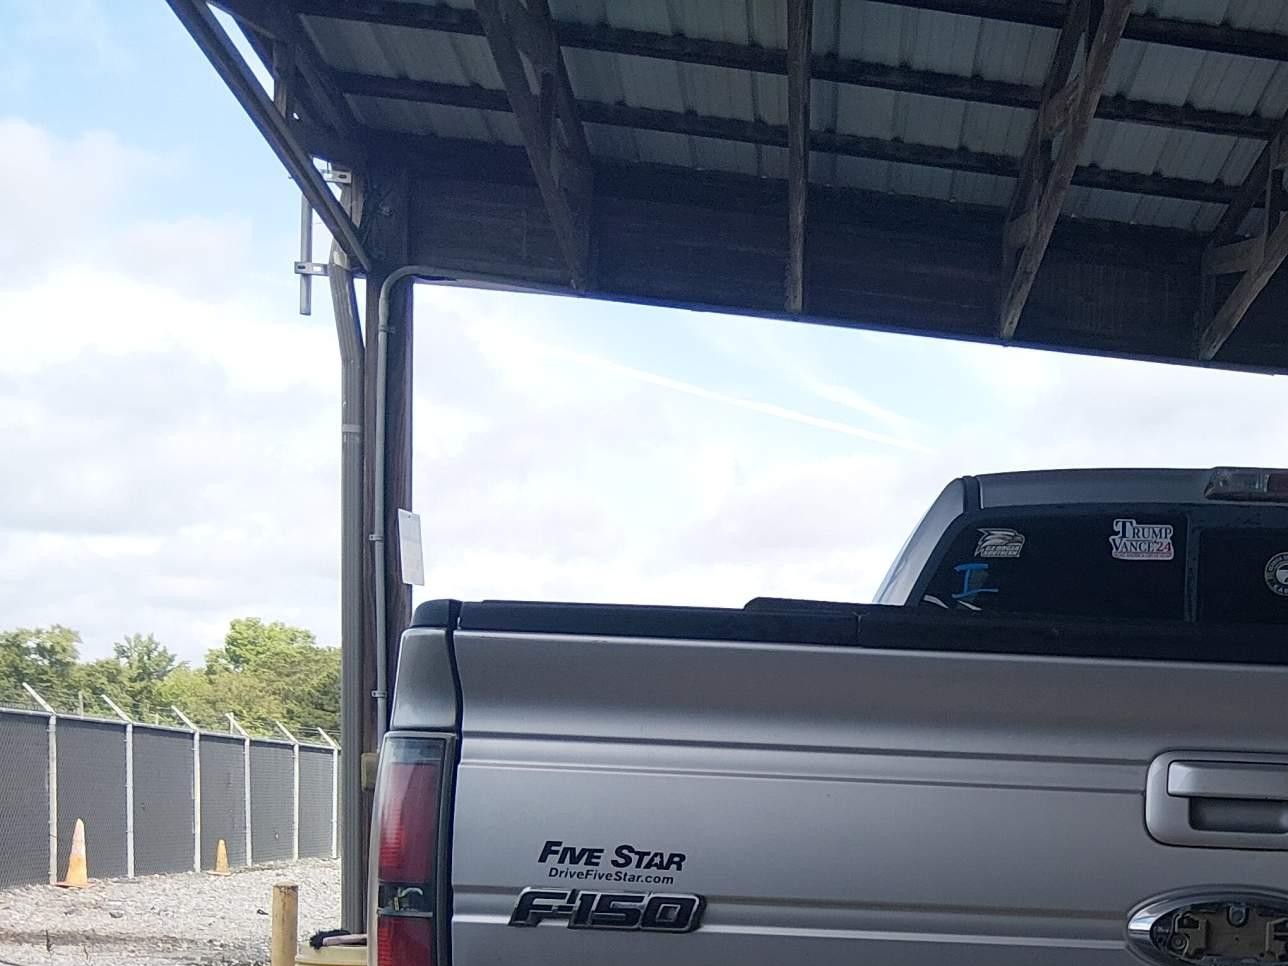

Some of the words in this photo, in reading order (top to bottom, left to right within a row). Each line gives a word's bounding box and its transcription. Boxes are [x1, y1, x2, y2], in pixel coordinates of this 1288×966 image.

[1114, 520, 1172, 540] TRUMP
[548, 867, 675, 885] DriveFiveStar.com
[508, 887, 706, 934] F-150
